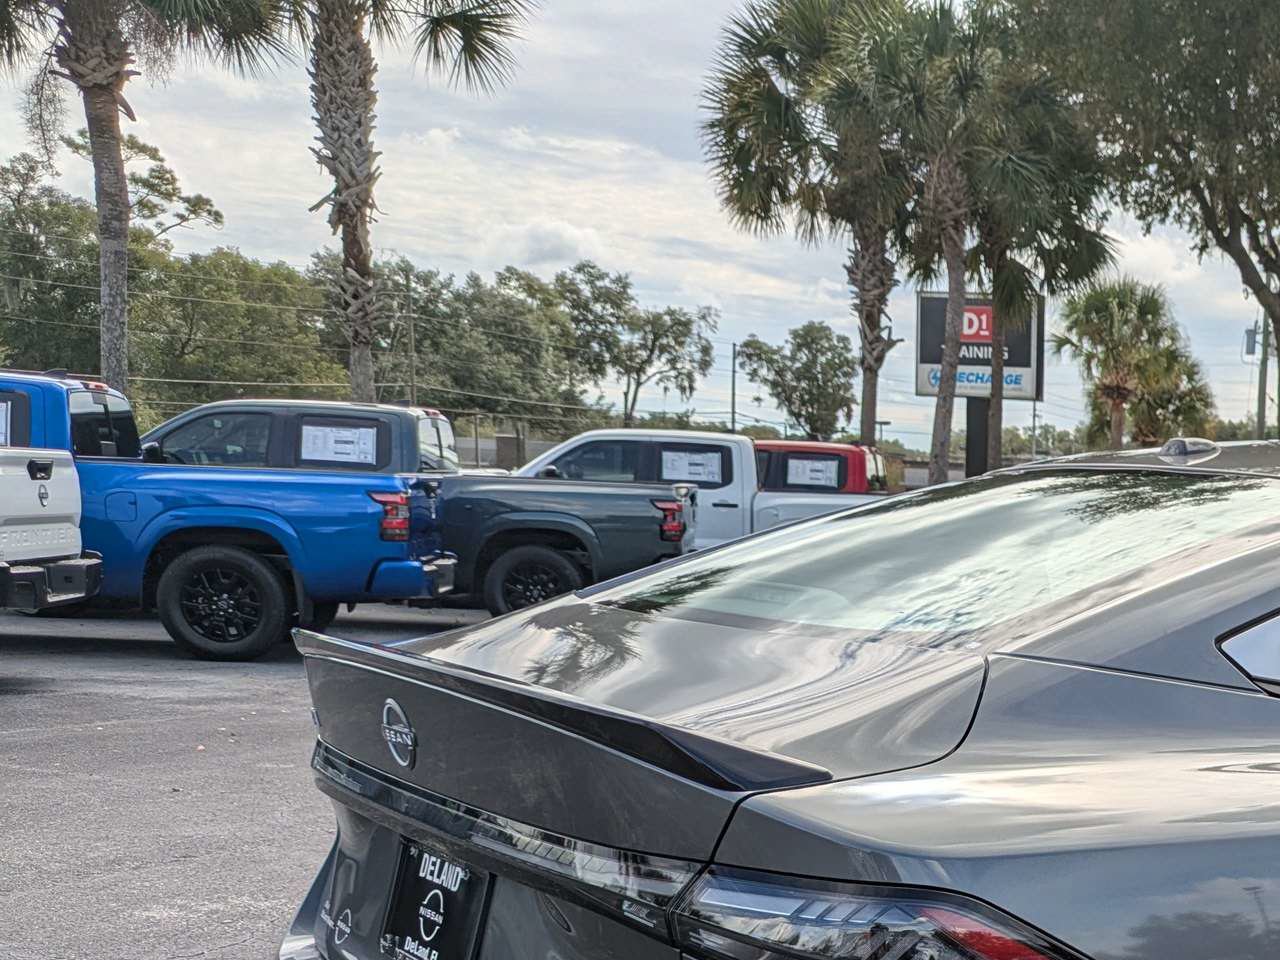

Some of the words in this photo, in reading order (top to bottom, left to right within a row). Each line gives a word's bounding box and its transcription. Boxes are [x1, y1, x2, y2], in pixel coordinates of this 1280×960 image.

[962, 311, 990, 336] D1
[953, 371, 1023, 386] ECHAGE
[418, 853, 463, 892] DELAND
[418, 906, 444, 925] NISSAN
